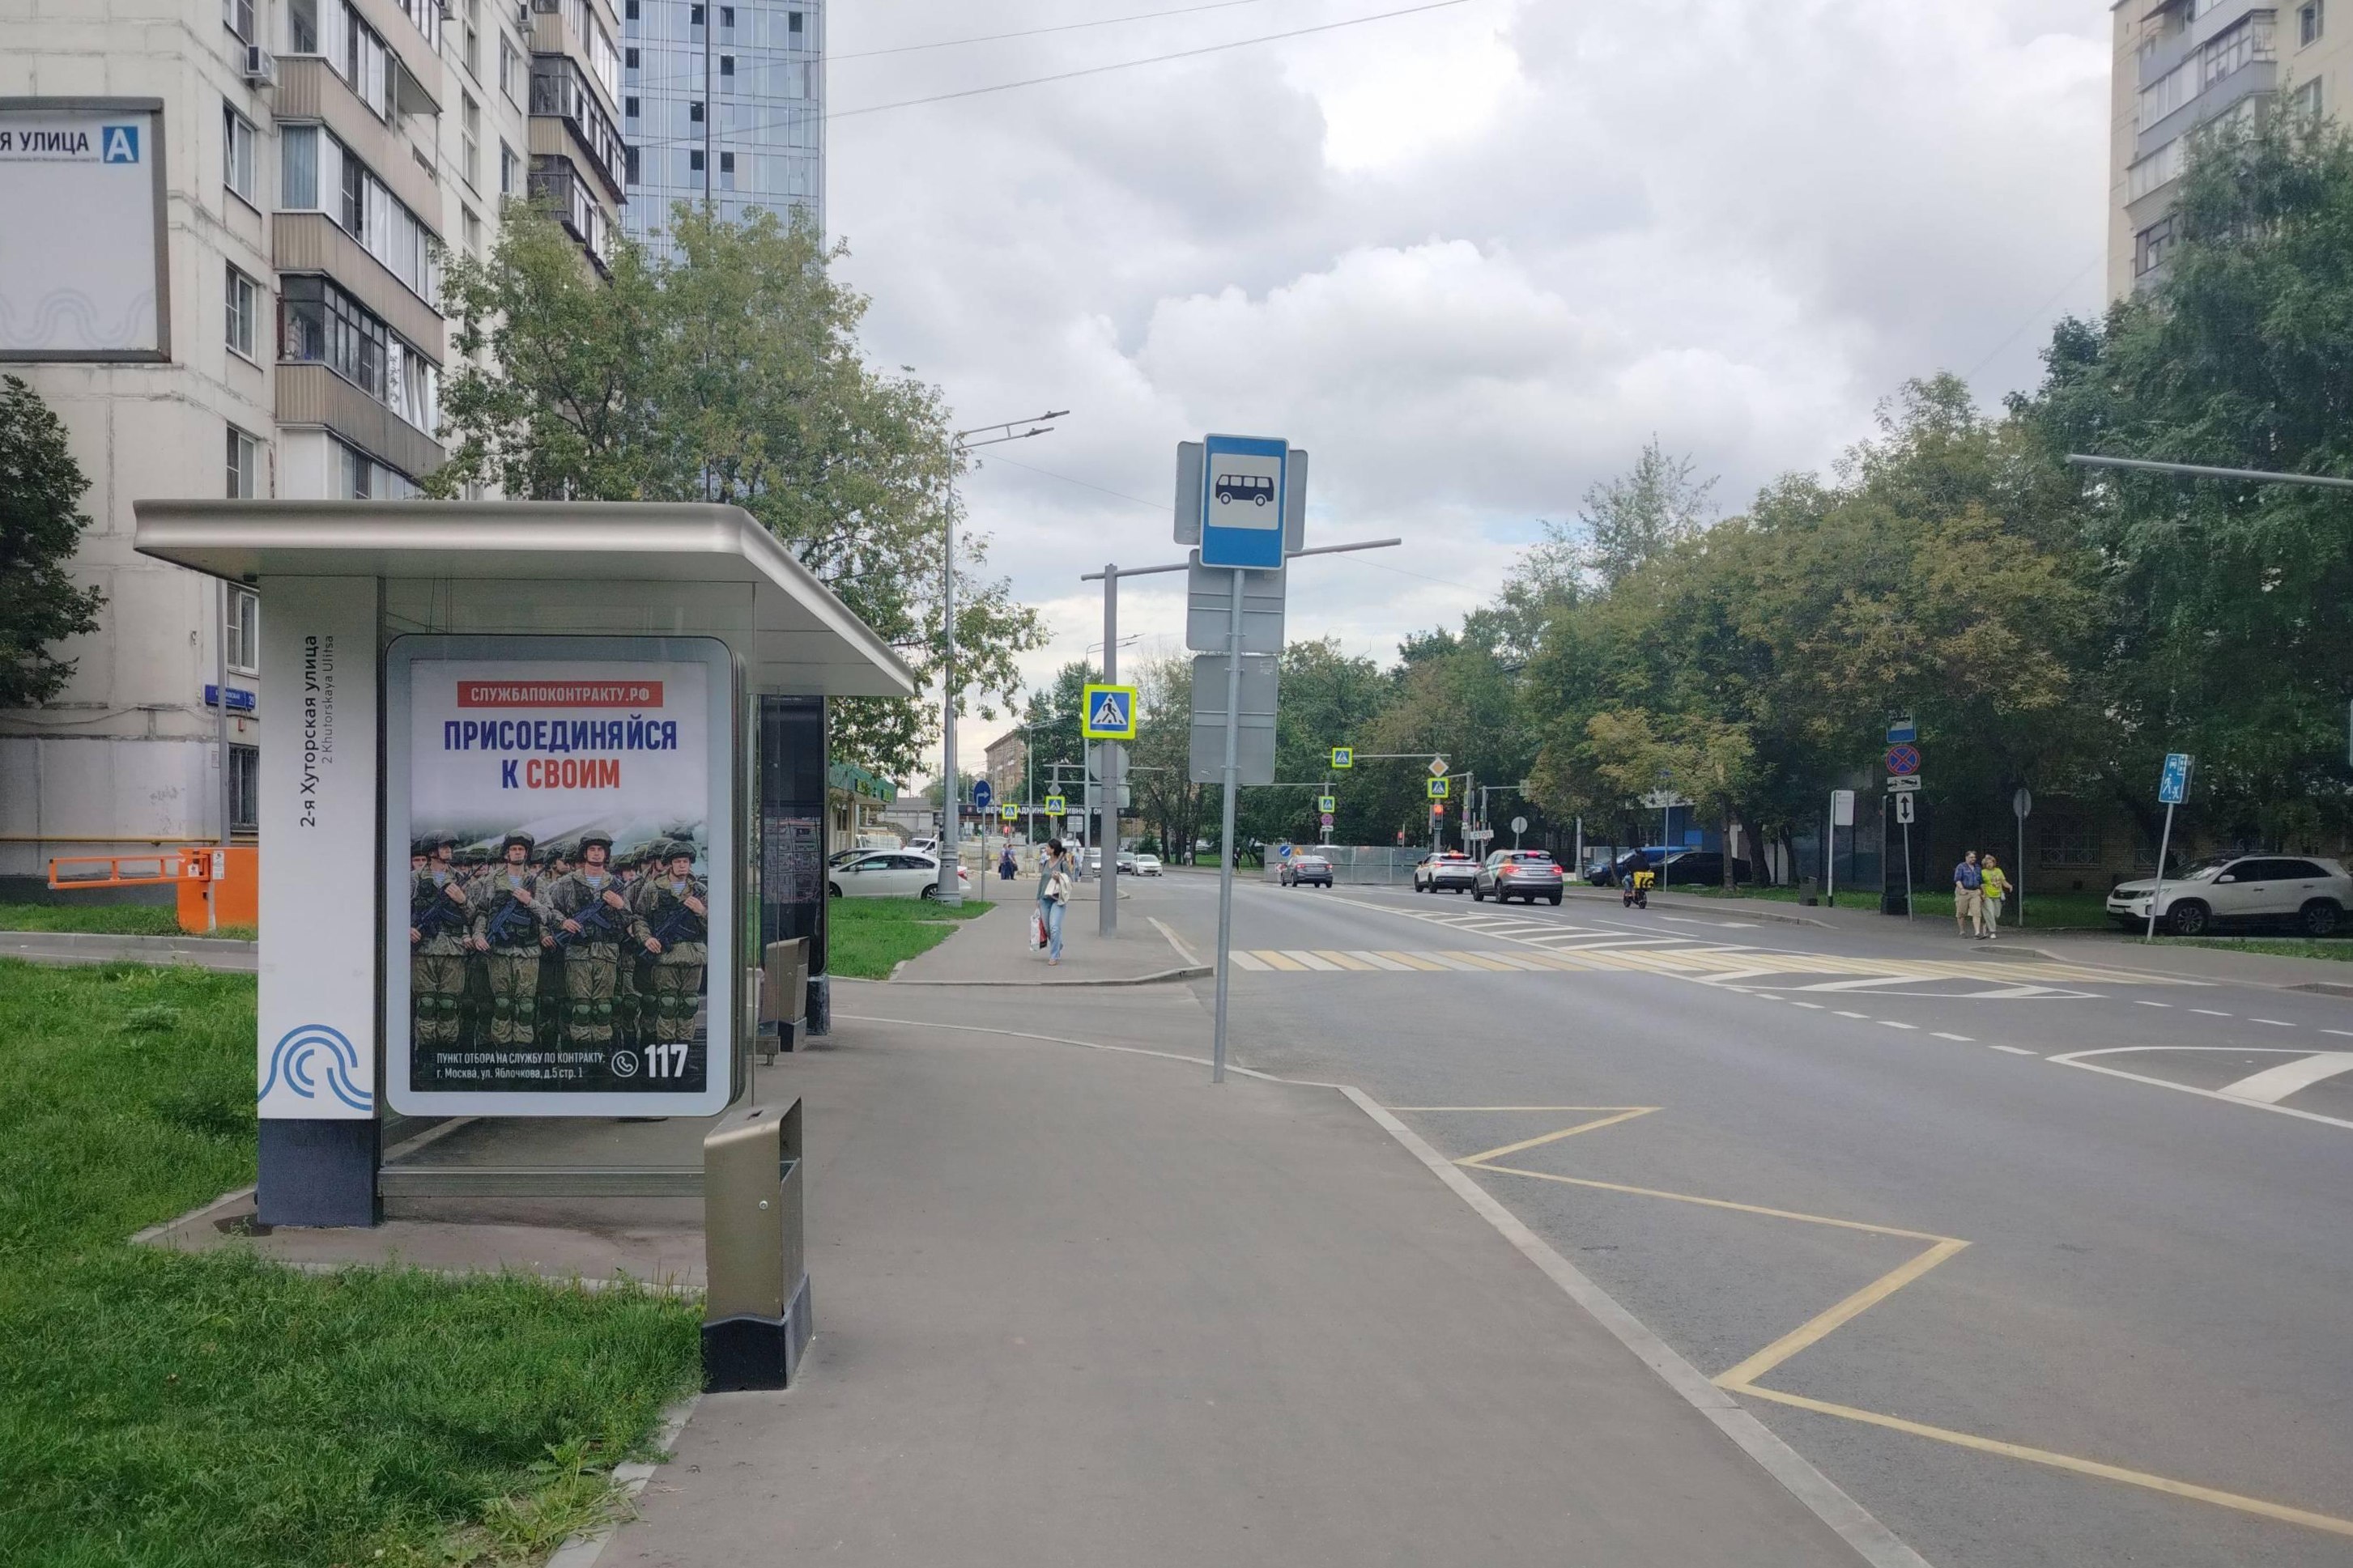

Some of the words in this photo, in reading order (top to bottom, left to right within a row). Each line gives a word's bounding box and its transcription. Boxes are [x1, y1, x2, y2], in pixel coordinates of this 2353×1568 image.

[19, 132, 89, 155] УЛИЦА
[304, 635, 319, 691] улица
[322, 635, 334, 671] Ulitsa
[470, 687, 650, 702] СЛУЖБАПОКОНТРАКТУ.РФ
[322, 676, 334, 754] Khutorskaya
[300, 697, 319, 794] Хуторская
[445, 714, 677, 753] ПРИСОЕДИНЯЙСЯ
[502, 759, 519, 789] К
[526, 759, 619, 789] СВОИМ
[300, 800, 315, 827] 2-я
[437, 1052, 462, 1064] ПУНКТ
[465, 1052, 496, 1064] ОТБОРА
[496, 1052, 508, 1064] НА
[509, 1052, 543, 1064] СЛУЖБУ
[544, 1052, 555, 1064] ПО
[557, 1052, 606, 1064] КОНТРАКТУ:
[645, 1044, 688, 1077] 117
[437, 1069, 443, 1078] г.
[445, 1068, 479, 1080] Москва,
[481, 1069, 492, 1081] ул.
[495, 1068, 543, 1080] Яблочкова,
[543, 1068, 558, 1080] д.5
[559, 1069, 577, 1080] стр.
[578, 1067, 584, 1077] 1
